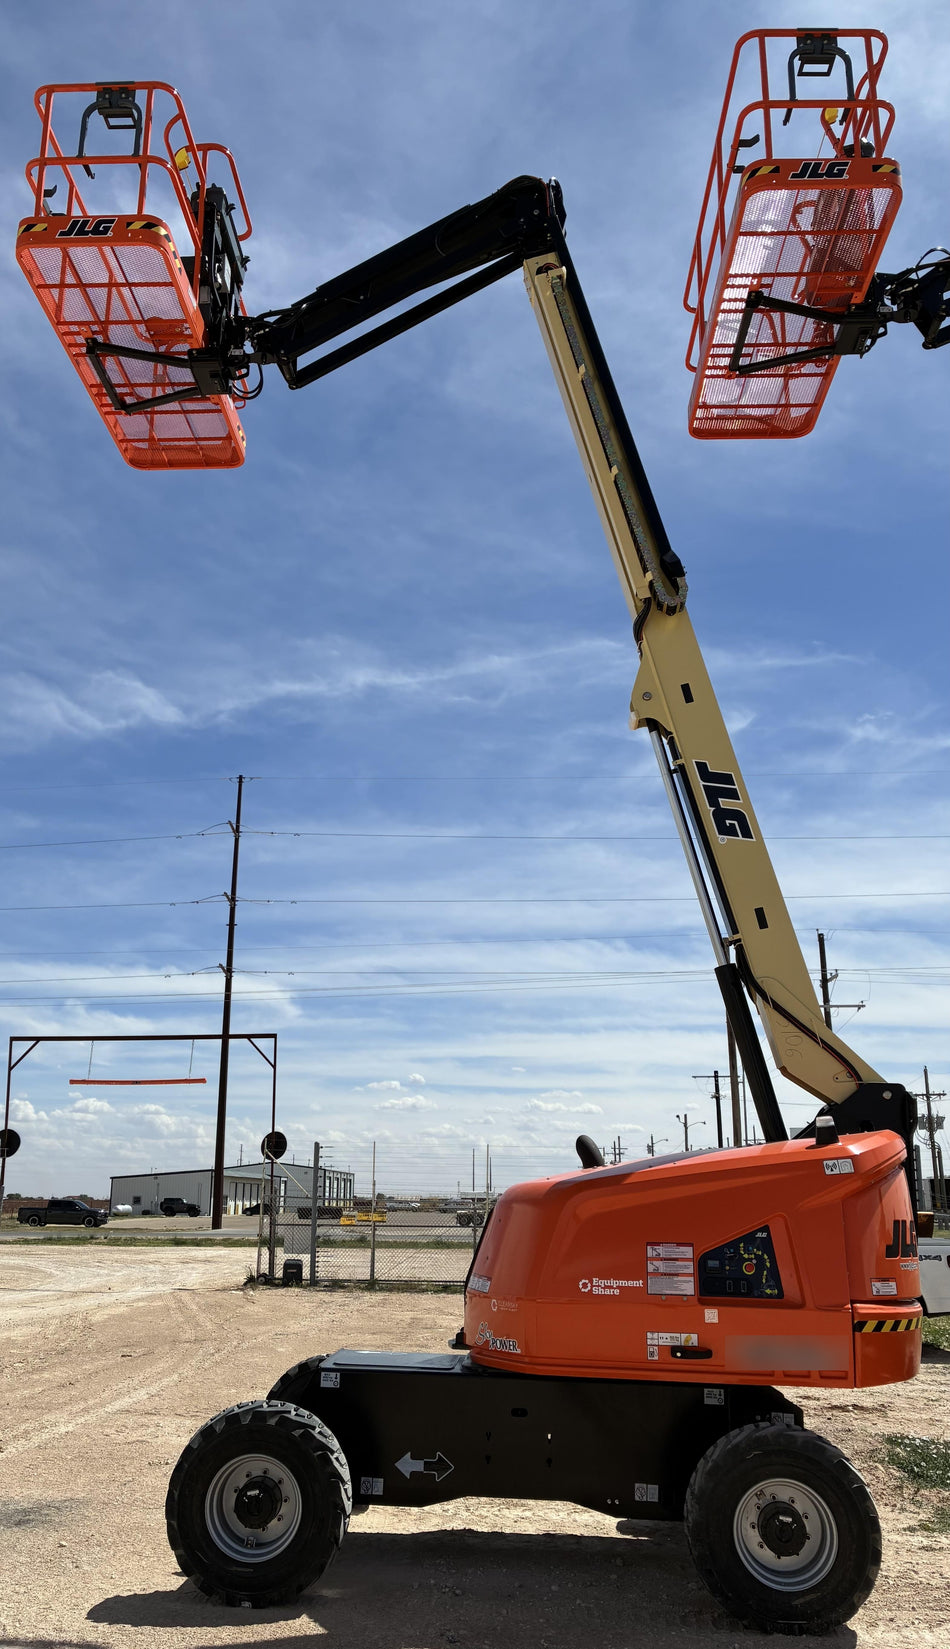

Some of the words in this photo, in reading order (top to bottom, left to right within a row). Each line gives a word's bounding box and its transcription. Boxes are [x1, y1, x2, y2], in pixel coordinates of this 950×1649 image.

[788, 160, 851, 181] JLG
[56, 218, 118, 238] JLG
[592, 1277, 644, 1288] Equipment
[592, 1286, 620, 1295] Share
